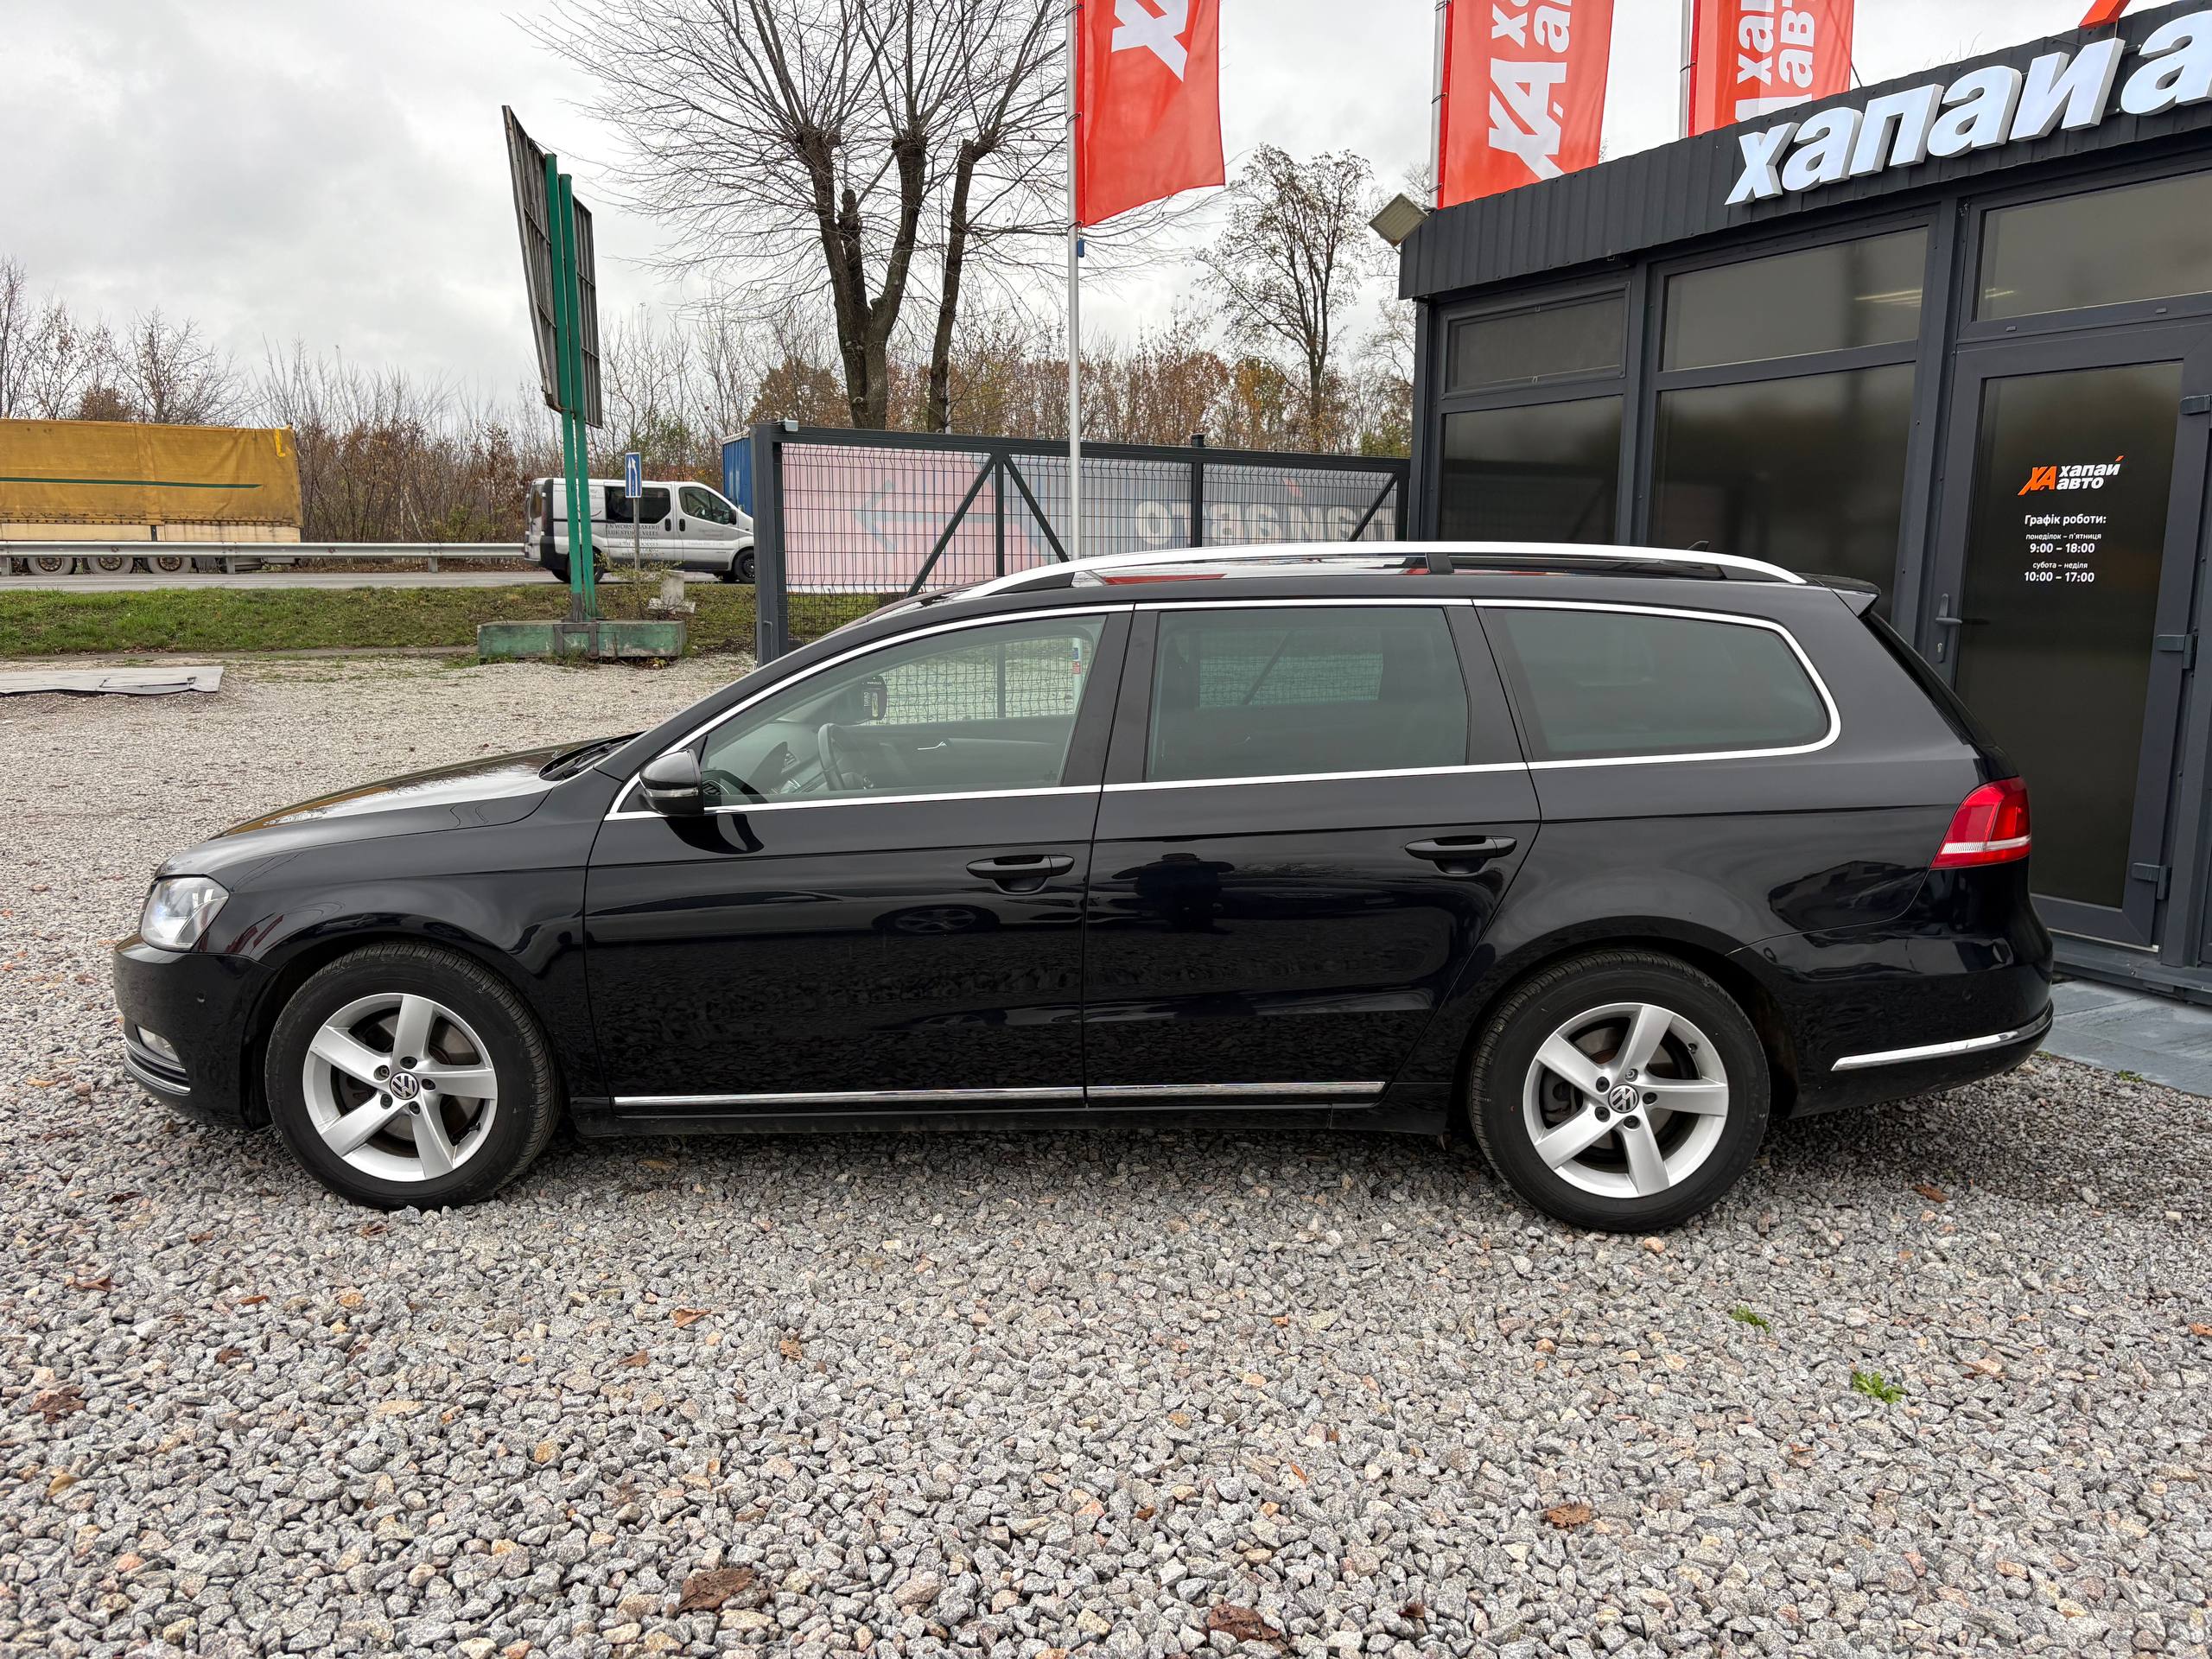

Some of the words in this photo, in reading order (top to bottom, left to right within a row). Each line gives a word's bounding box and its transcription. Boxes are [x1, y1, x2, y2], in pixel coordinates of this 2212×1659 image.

[1778, 0, 1815, 88] ав
[2058, 455, 2126, 478] хапай
[2056, 477, 2105, 490] авто
[2024, 514, 2061, 527] Графік
[2063, 514, 2107, 526] роботи:
[2030, 543, 2054, 553] 9:00
[2065, 543, 2095, 553] 18:00
[2024, 571, 2053, 582] 10:00
[2064, 572, 2095, 582] 17:00
